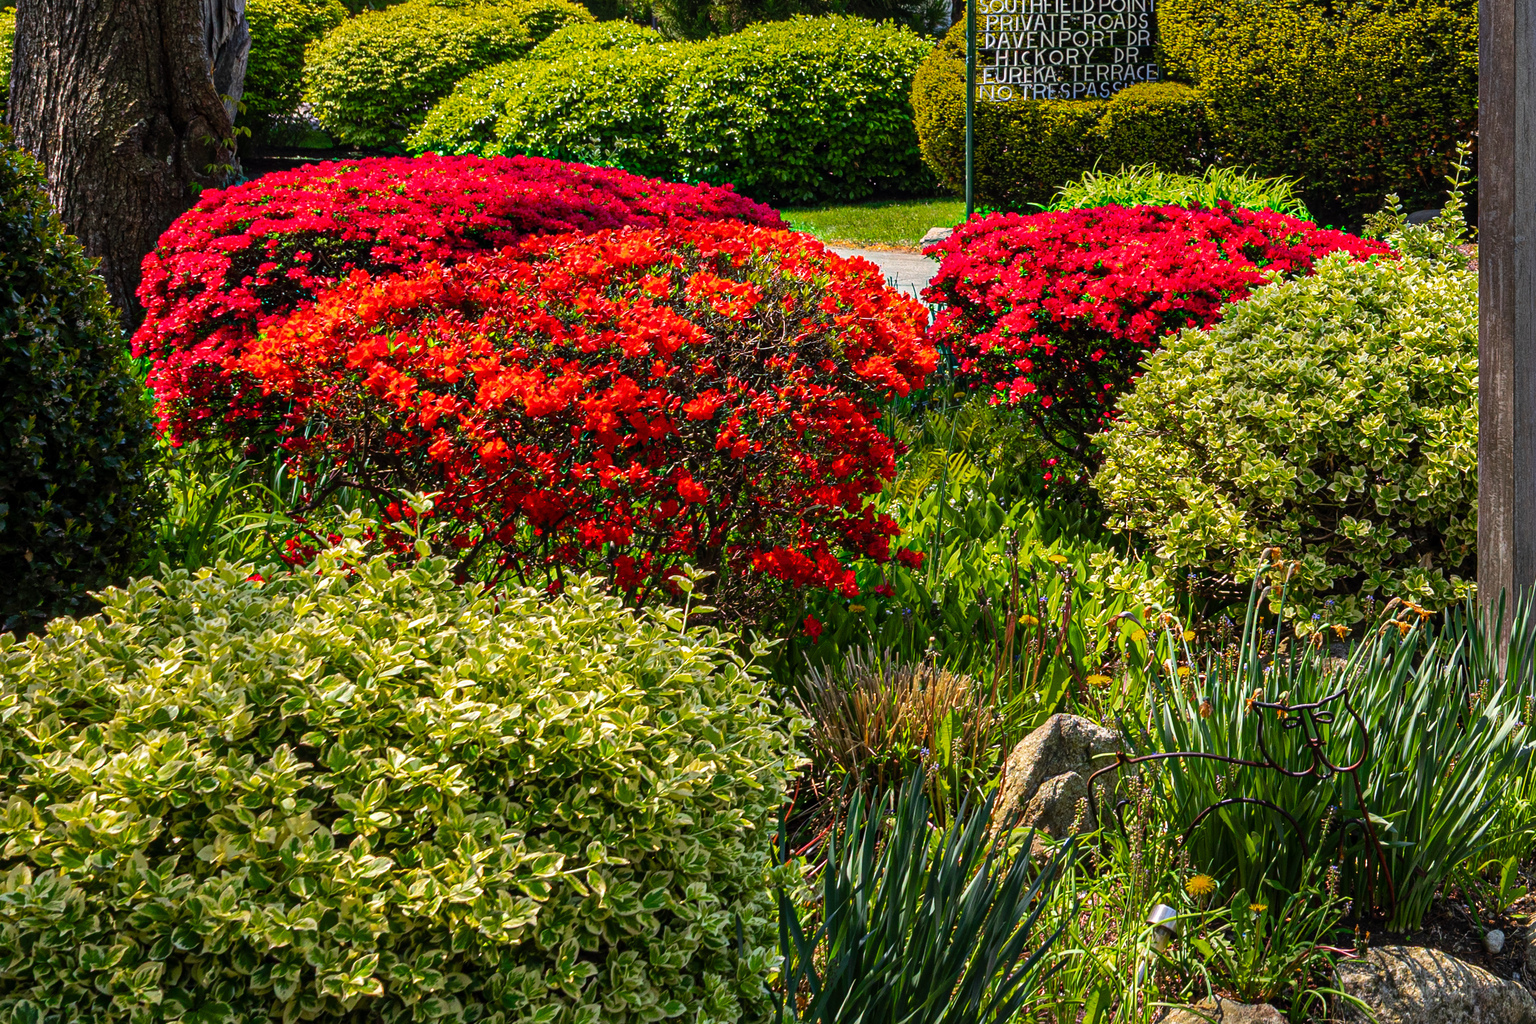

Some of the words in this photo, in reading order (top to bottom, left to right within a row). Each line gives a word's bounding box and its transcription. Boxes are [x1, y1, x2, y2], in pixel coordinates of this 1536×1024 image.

[985, 13, 1072, 32] PRIVATE
[1083, 12, 1149, 30] ROADS
[985, 30, 1118, 50] DAVENPORT
[1127, 30, 1150, 47] DR
[995, 47, 1095, 67] HICKORY
[1115, 47, 1139, 64] DR
[983, 65, 1058, 85] EUREKA
[1070, 64, 1158, 82] TERRACE
[979, 84, 1013, 102] NO
[1020, 81, 1141, 101] TRESPASS
